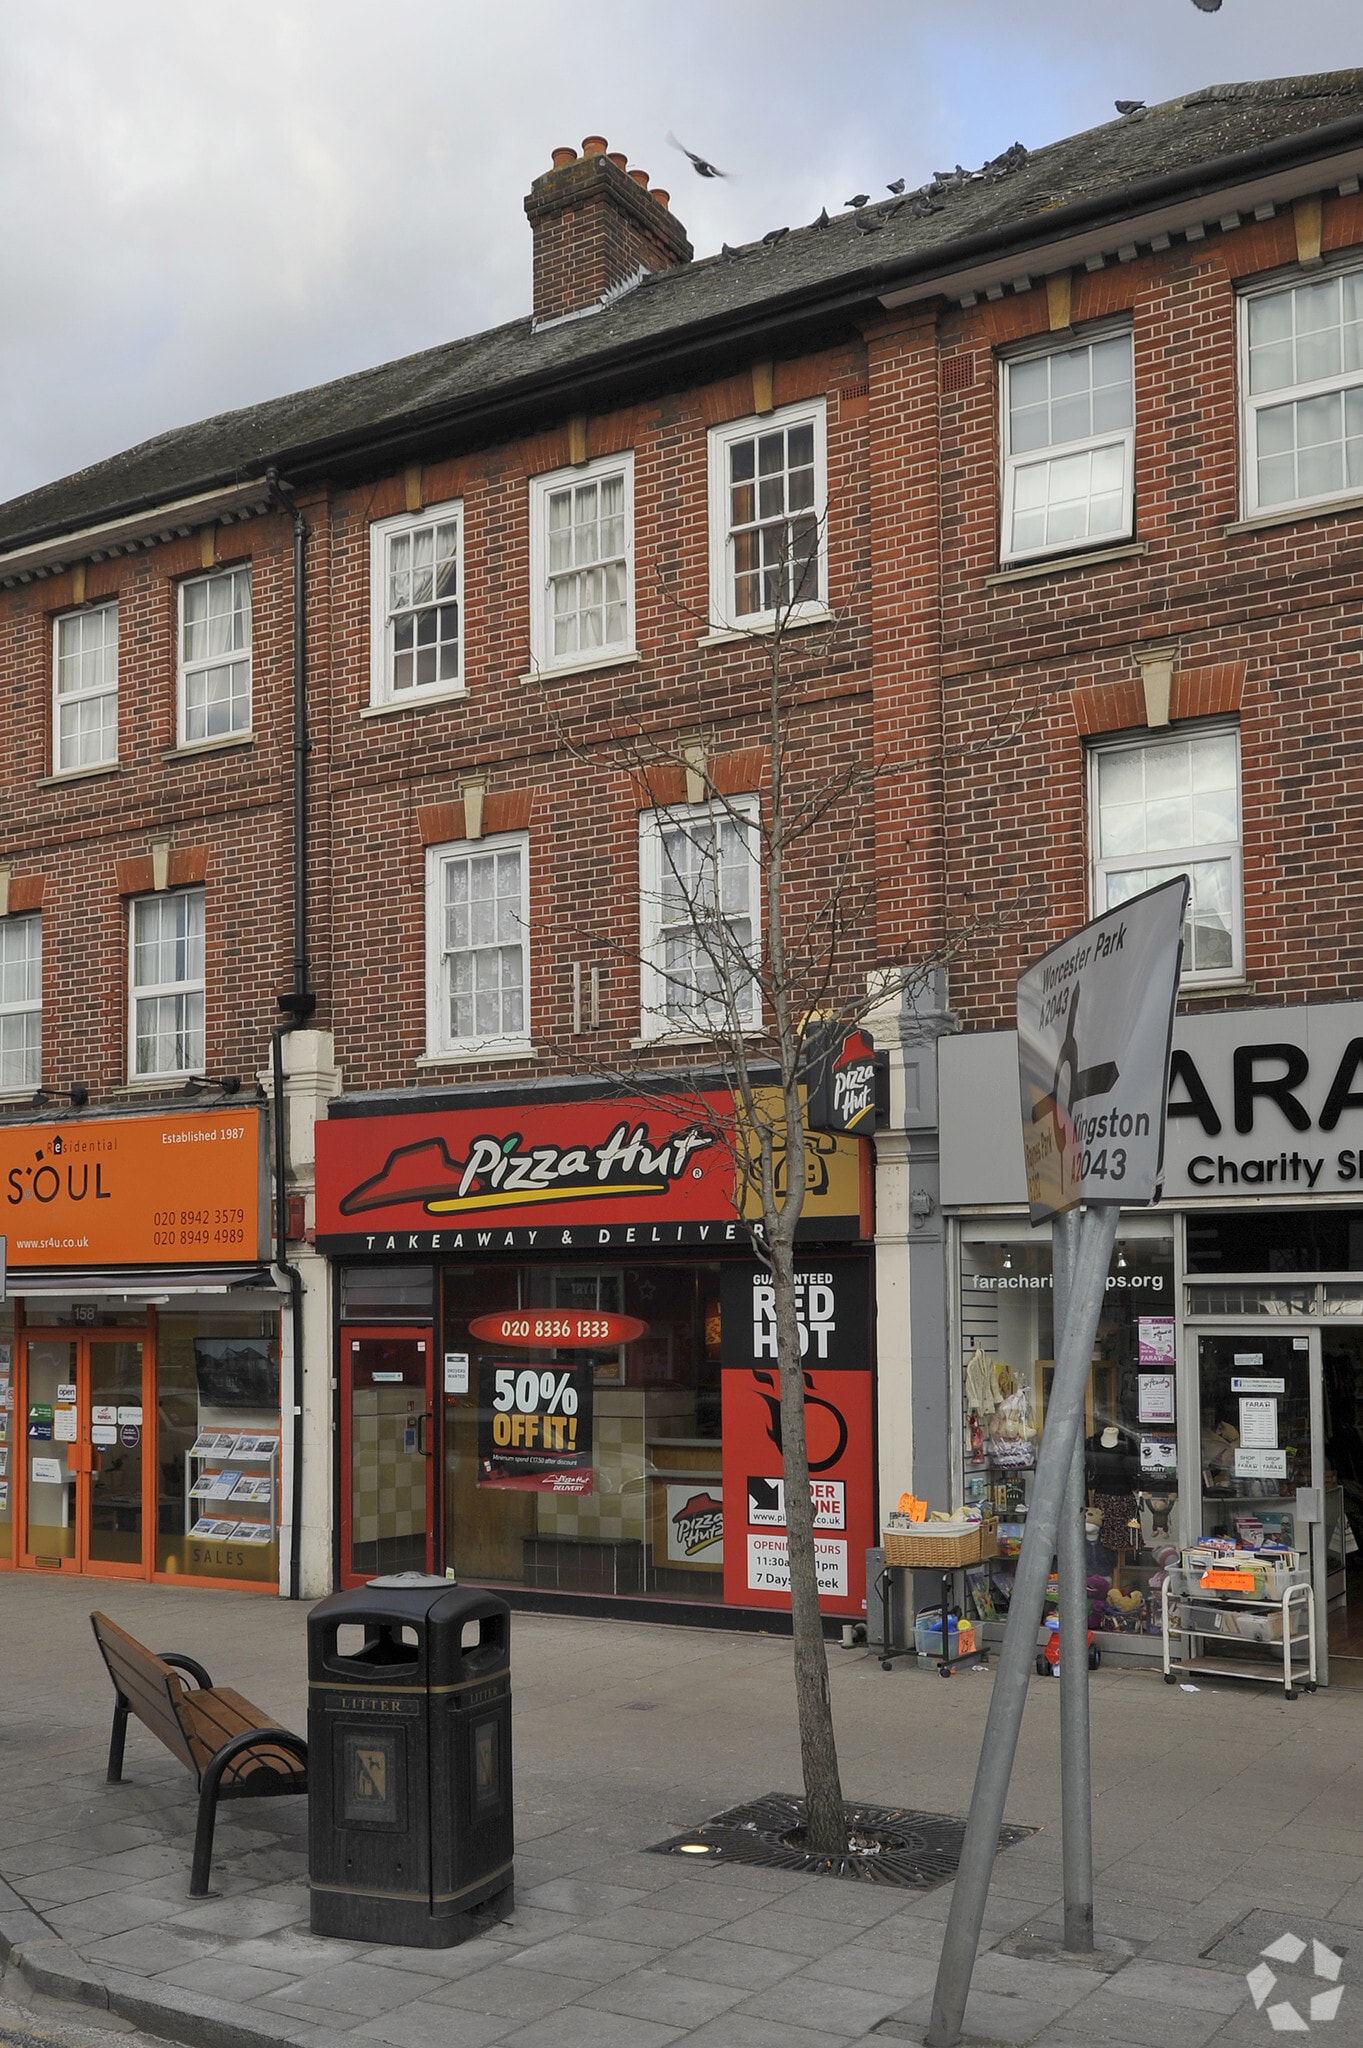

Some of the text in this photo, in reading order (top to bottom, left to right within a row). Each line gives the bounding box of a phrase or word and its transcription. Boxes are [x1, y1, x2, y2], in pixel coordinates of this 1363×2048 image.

[1042, 922, 1127, 994] Worcester Park
[1039, 987, 1069, 1031] A2043
[834, 1063, 874, 1110] Pizza
[1167, 1037, 1363, 1135] ARA
[842, 1085, 871, 1121] Hut
[162, 1128, 244, 1144] Established 1987
[1073, 1107, 1150, 1145] Kingston
[47, 1138, 118, 1154] Residential
[458, 1127, 712, 1197] Pizza Hut
[1071, 1148, 1127, 1184] A2043
[1187, 1152, 1325, 1188] Charity
[7, 1163, 111, 1205] SOUL
[154, 1209, 244, 1226] 020 8942 3579
[16, 1236, 89, 1248] www.sr4u.co.uk
[154, 1229, 244, 1245] 020 8949 4989
[366, 1223, 766, 1250] TAKEAWAY & DELIVER
[74, 1307, 95, 1320] 158
[501, 1320, 609, 1338] 020 8336 1333
[59, 1388, 75, 1397] open
[493, 1370, 578, 1415] 50%
[493, 1413, 577, 1450] OFF IT!
[193, 1548, 243, 1566] SALES
[756, 1573, 763, 1583] 7
[816, 1577, 839, 1588] eek
[342, 1698, 400, 1711] LITTER
